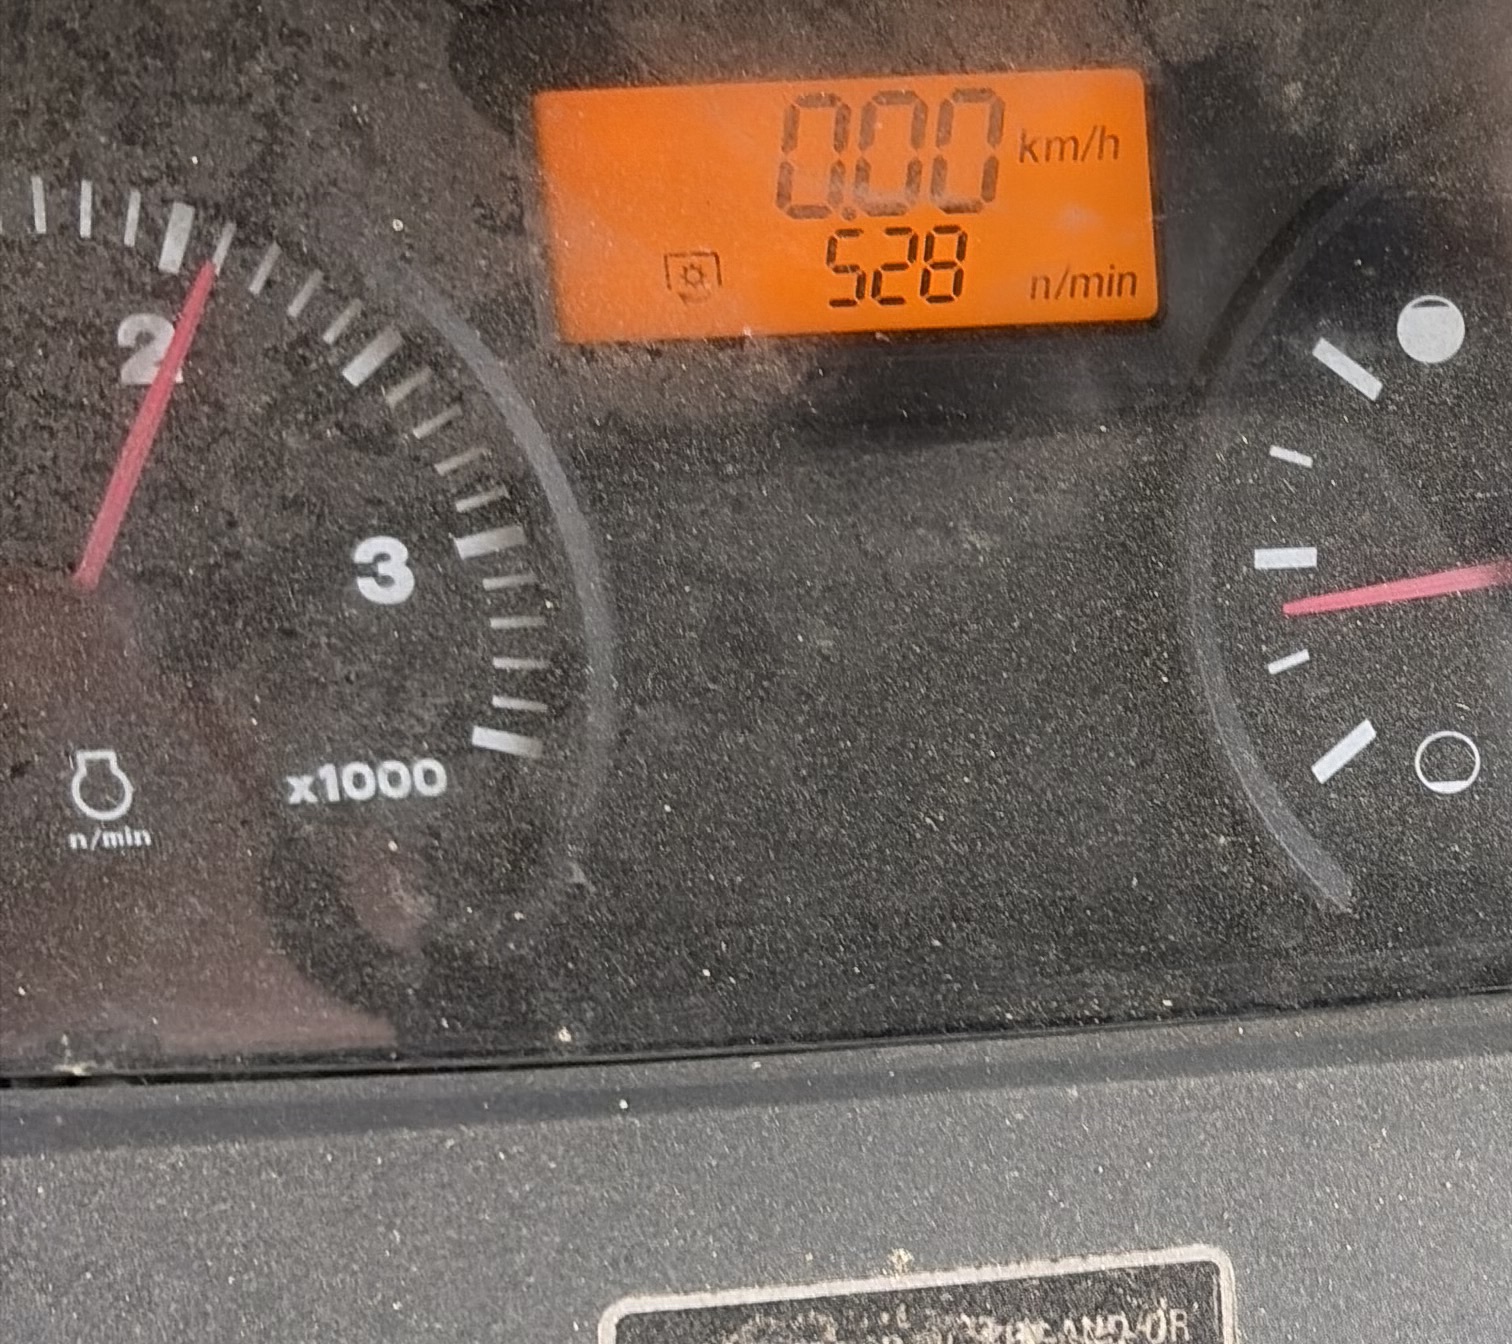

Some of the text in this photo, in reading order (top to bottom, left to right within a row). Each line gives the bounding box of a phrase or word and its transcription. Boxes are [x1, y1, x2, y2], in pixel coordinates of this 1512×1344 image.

[776, 87, 1120, 221] 0.00 km/h
[826, 224, 1138, 308] 528 n/min
[116, 313, 184, 385] 2
[353, 536, 416, 606] 3
[287, 758, 448, 806] x1000
[68, 827, 152, 850] n/min
